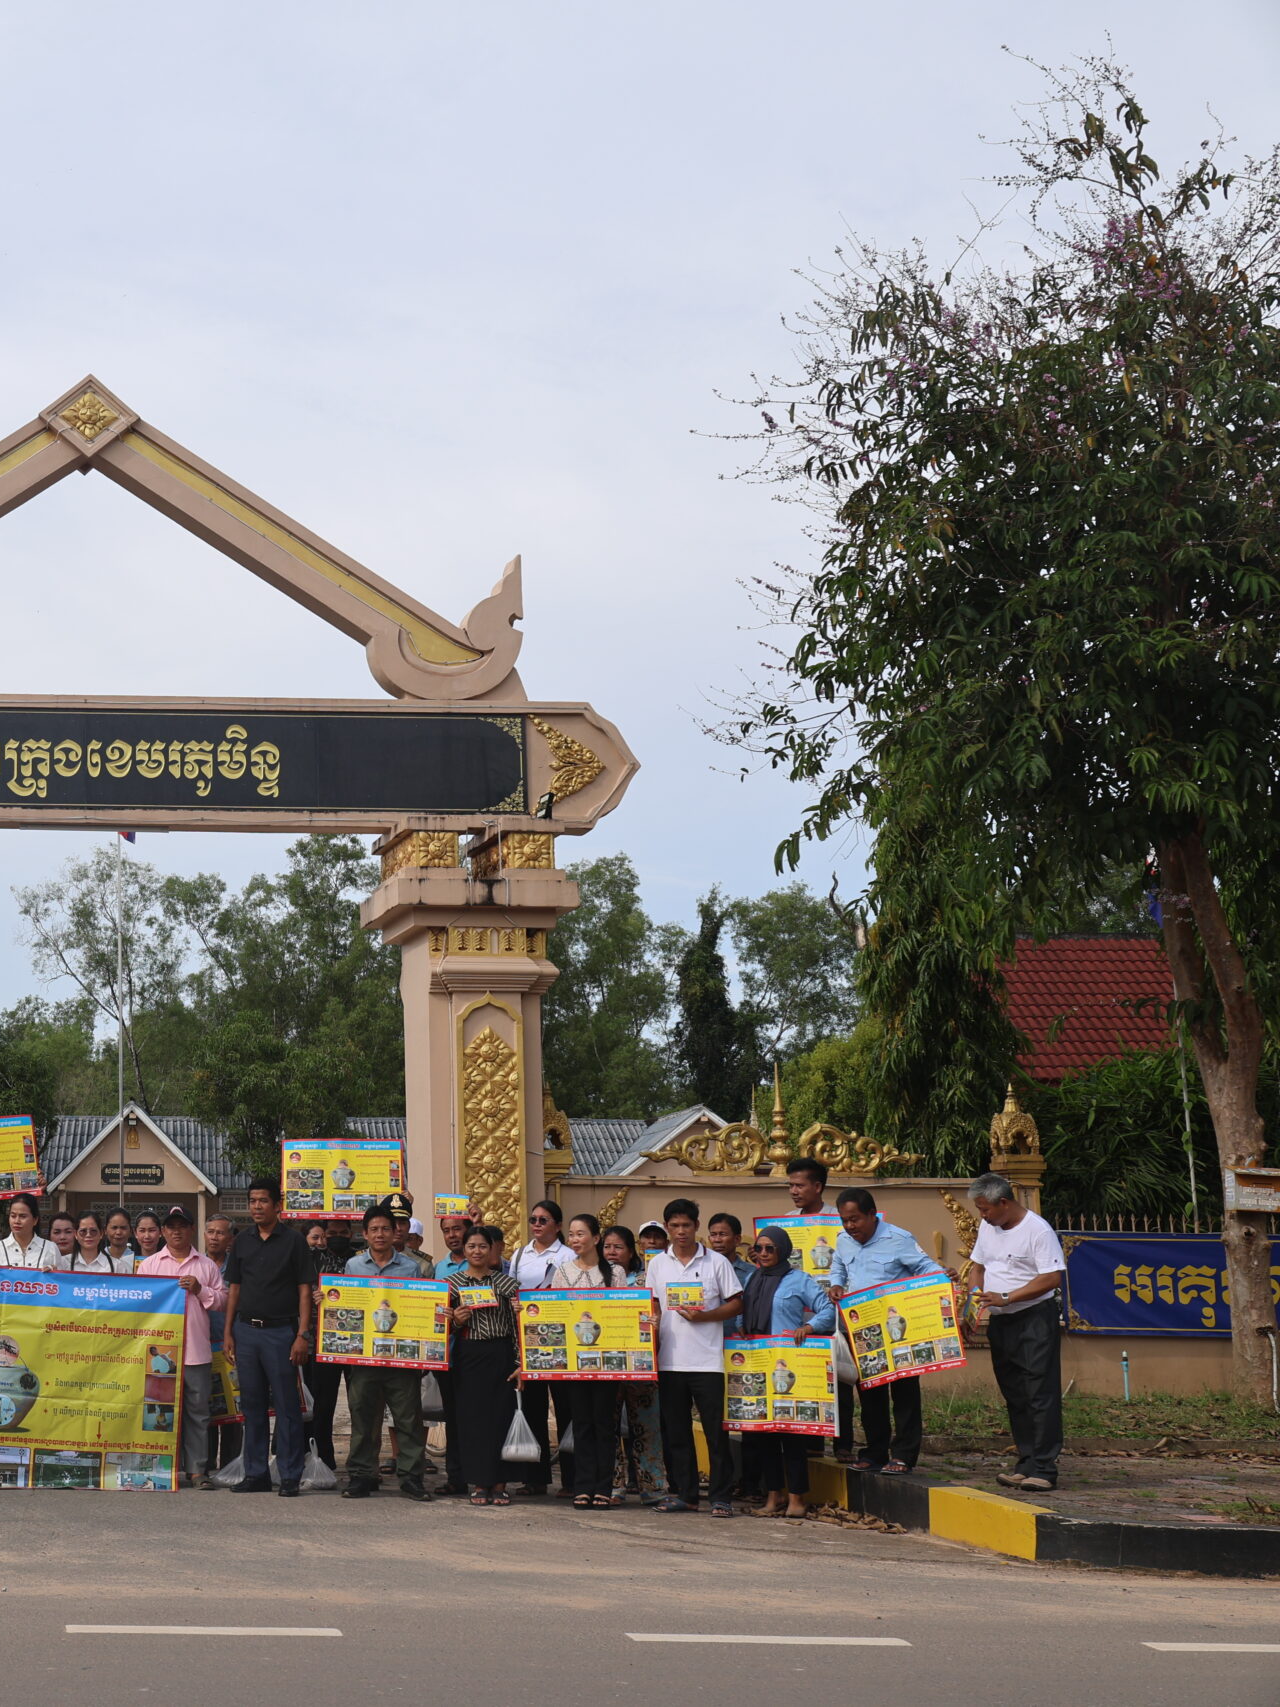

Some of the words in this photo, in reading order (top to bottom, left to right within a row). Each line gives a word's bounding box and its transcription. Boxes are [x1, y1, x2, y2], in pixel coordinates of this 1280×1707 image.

[72, 1284, 153, 1301] សម្លាប់អ្នកបាន
